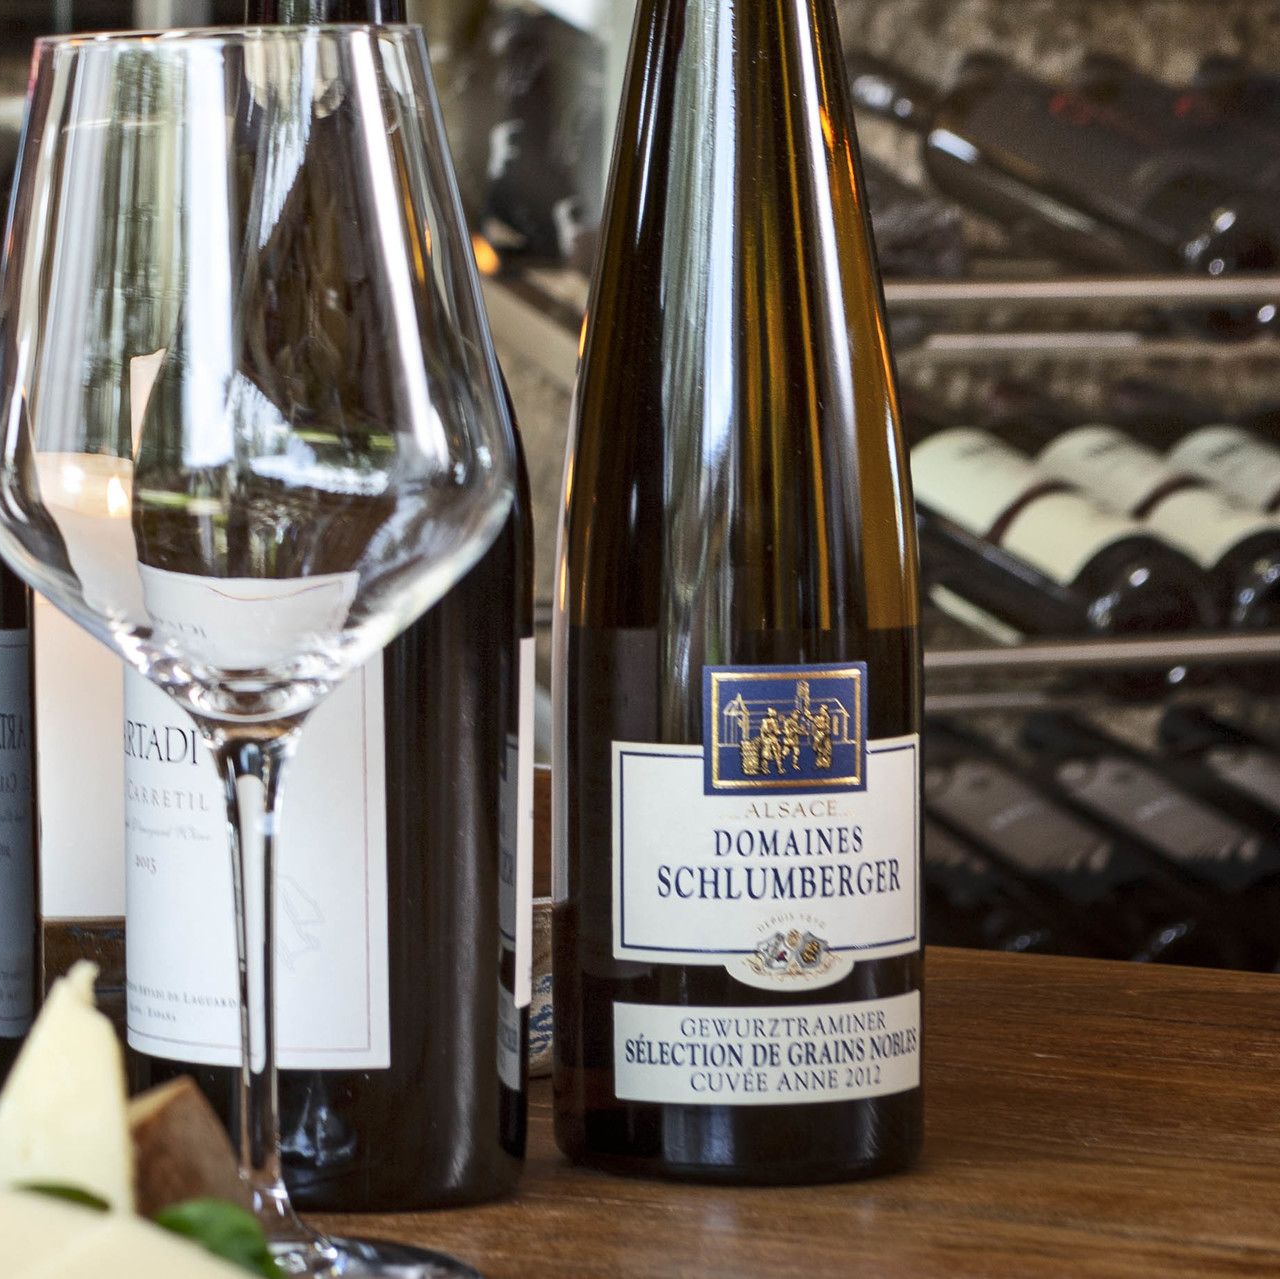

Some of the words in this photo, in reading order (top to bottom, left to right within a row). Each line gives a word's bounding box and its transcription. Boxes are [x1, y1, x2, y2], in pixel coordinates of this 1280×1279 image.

[744, 799, 839, 820] ALSACE
[714, 825, 864, 858] DOMAINES
[656, 858, 902, 900] SCHLUMBERGER
[680, 1010, 887, 1039] GEWURZTRAMINER
[625, 1032, 744, 1068] SÉLECTION
[751, 1042, 782, 1067] DE
[787, 1037, 866, 1067] GRAINS
[690, 1066, 769, 1094] CUVÉE
[776, 1067, 839, 1093] ANNE
